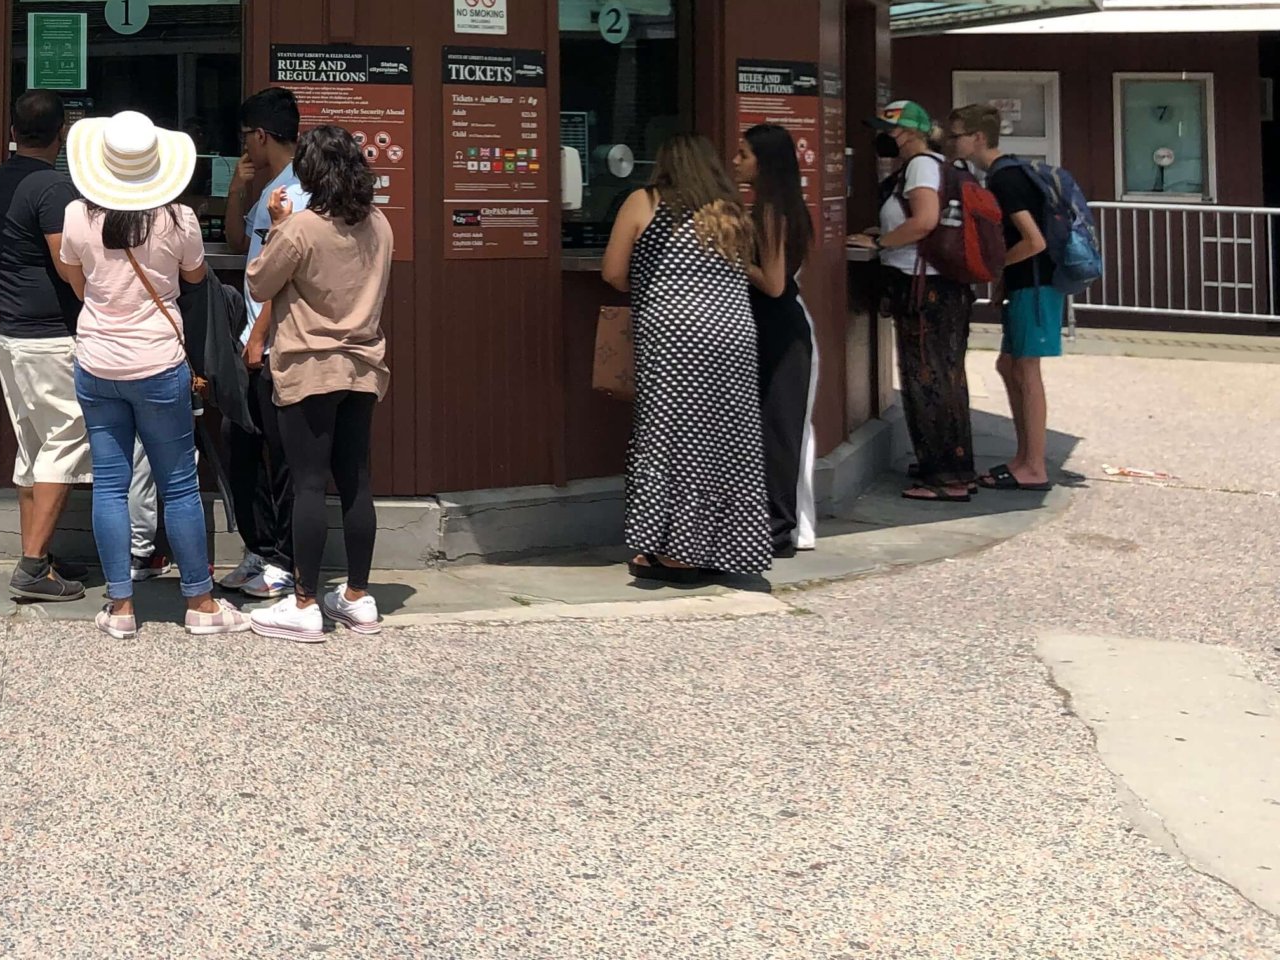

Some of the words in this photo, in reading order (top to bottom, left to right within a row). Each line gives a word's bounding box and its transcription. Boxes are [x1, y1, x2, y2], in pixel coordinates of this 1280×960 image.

[121, 0, 134, 26] 1
[456, 8, 468, 17] NO
[469, 9, 505, 19] SMOKING
[606, 8, 622, 34] 2
[277, 59, 316, 70] RULES
[318, 61, 347, 71] AND
[277, 71, 366, 82] REGULATIONS
[448, 64, 513, 82] TICKETS
[738, 73, 762, 83] RULES
[763, 74, 780, 83] AND
[738, 83, 793, 93] REGULATIONS
[452, 94, 474, 102] Tickets
[321, 108, 360, 116] Airport-style
[361, 108, 385, 116] Security
[1156, 106, 1168, 120] 7
[480, 208, 507, 216] CityPASS
